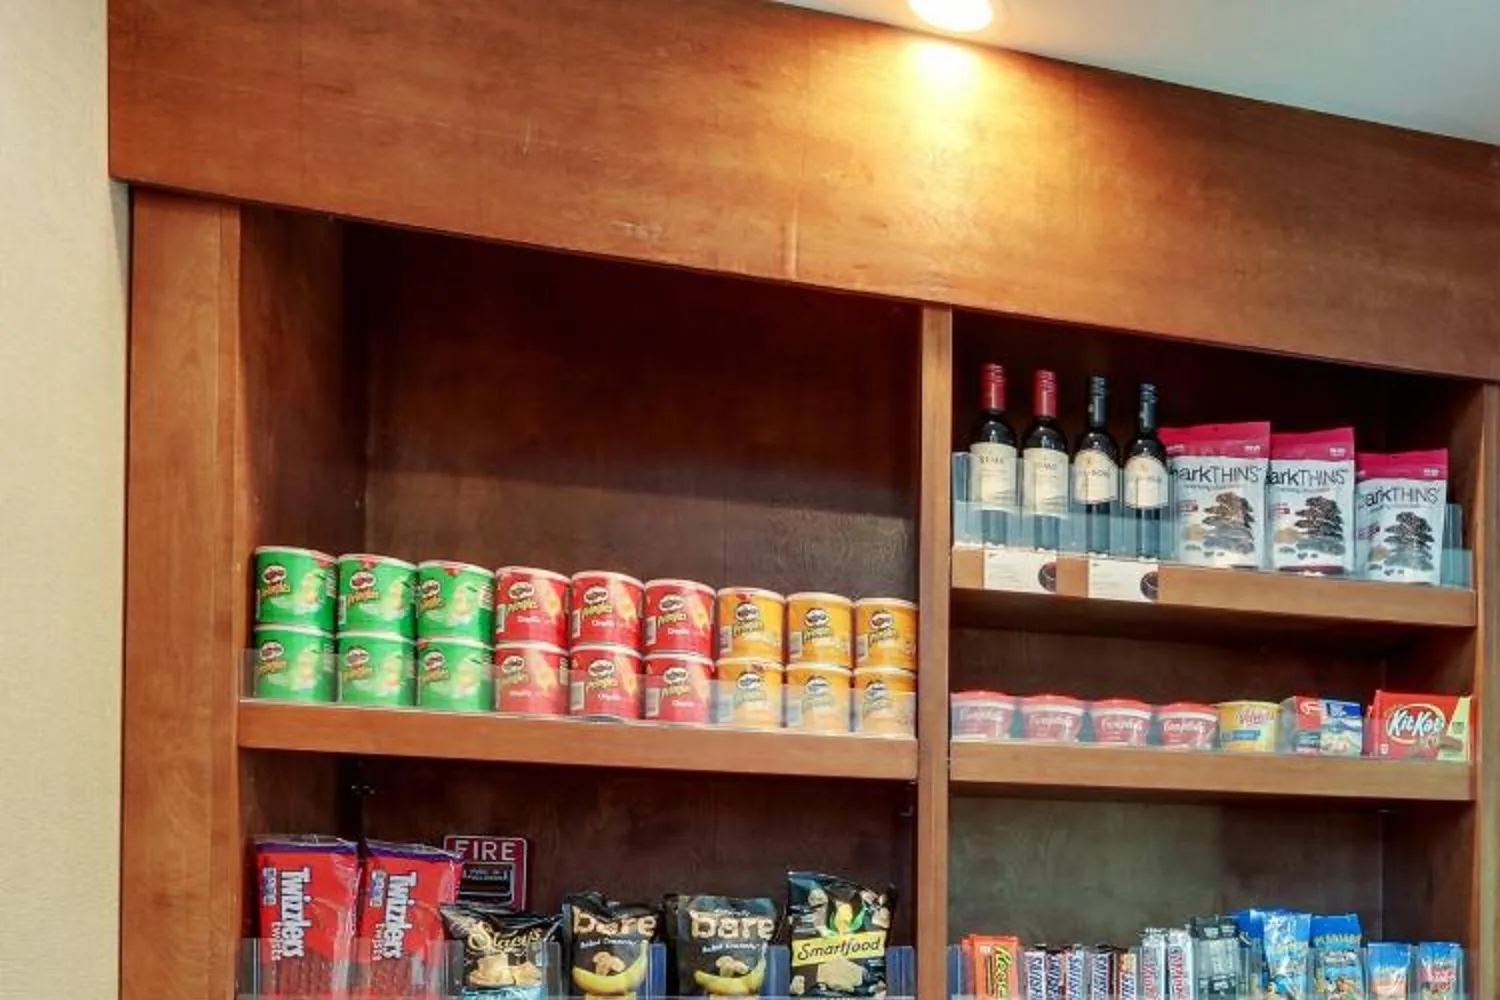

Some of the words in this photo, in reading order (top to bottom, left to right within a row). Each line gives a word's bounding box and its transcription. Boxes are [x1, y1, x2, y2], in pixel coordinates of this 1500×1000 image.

[1362, 487, 1440, 507] arkTHINS
[455, 841, 516, 861] FIRE
[797, 936, 881, 960] Smartfood
